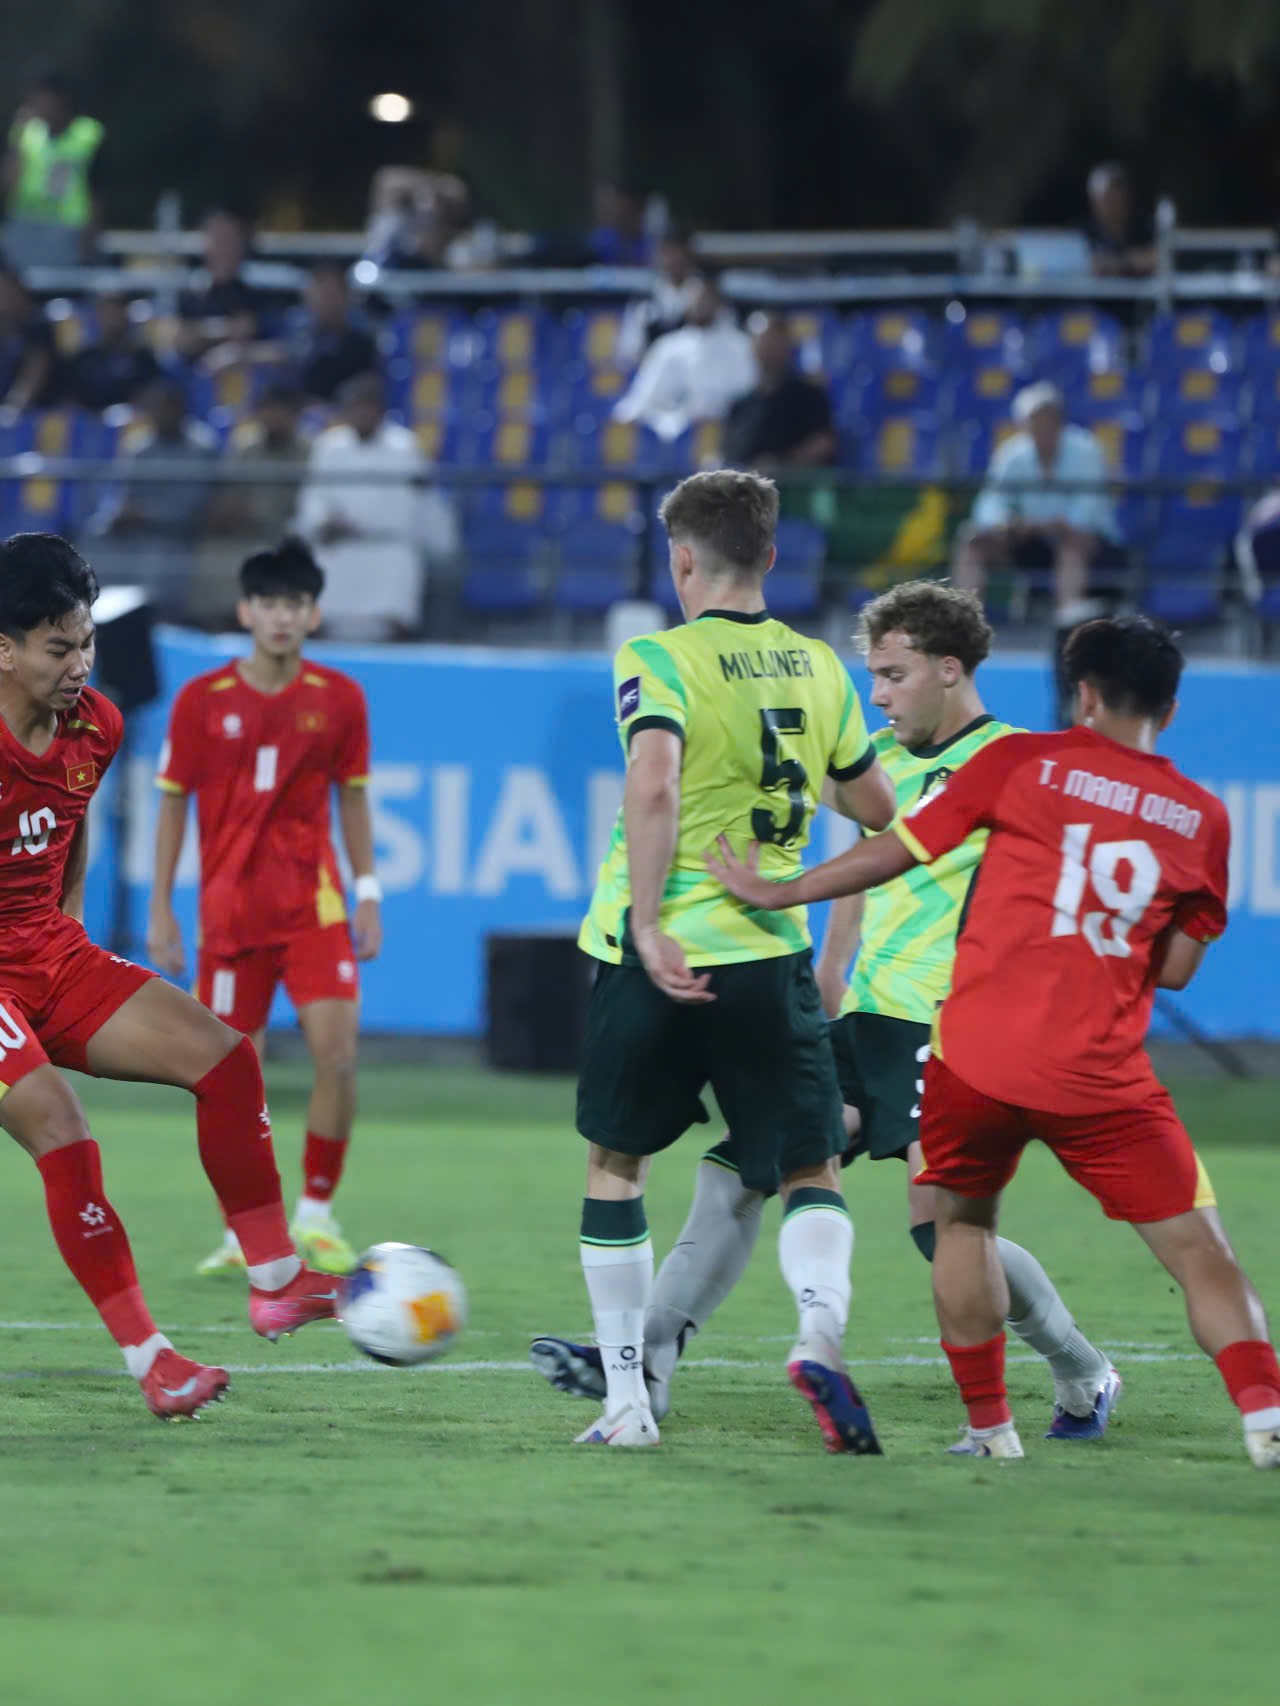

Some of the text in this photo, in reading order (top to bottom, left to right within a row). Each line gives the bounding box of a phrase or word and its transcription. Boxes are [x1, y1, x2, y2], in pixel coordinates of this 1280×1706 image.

[719, 650, 814, 682] MILLINER
[253, 745, 278, 792] 1
[751, 707, 809, 849] 5
[1039, 759, 1059, 790] T.
[1063, 769, 1139, 816] MANH
[11, 806, 57, 857] 10
[330, 763, 624, 899] SIA
[1050, 823, 1162, 958] 19
[212, 970, 236, 1016] 1
